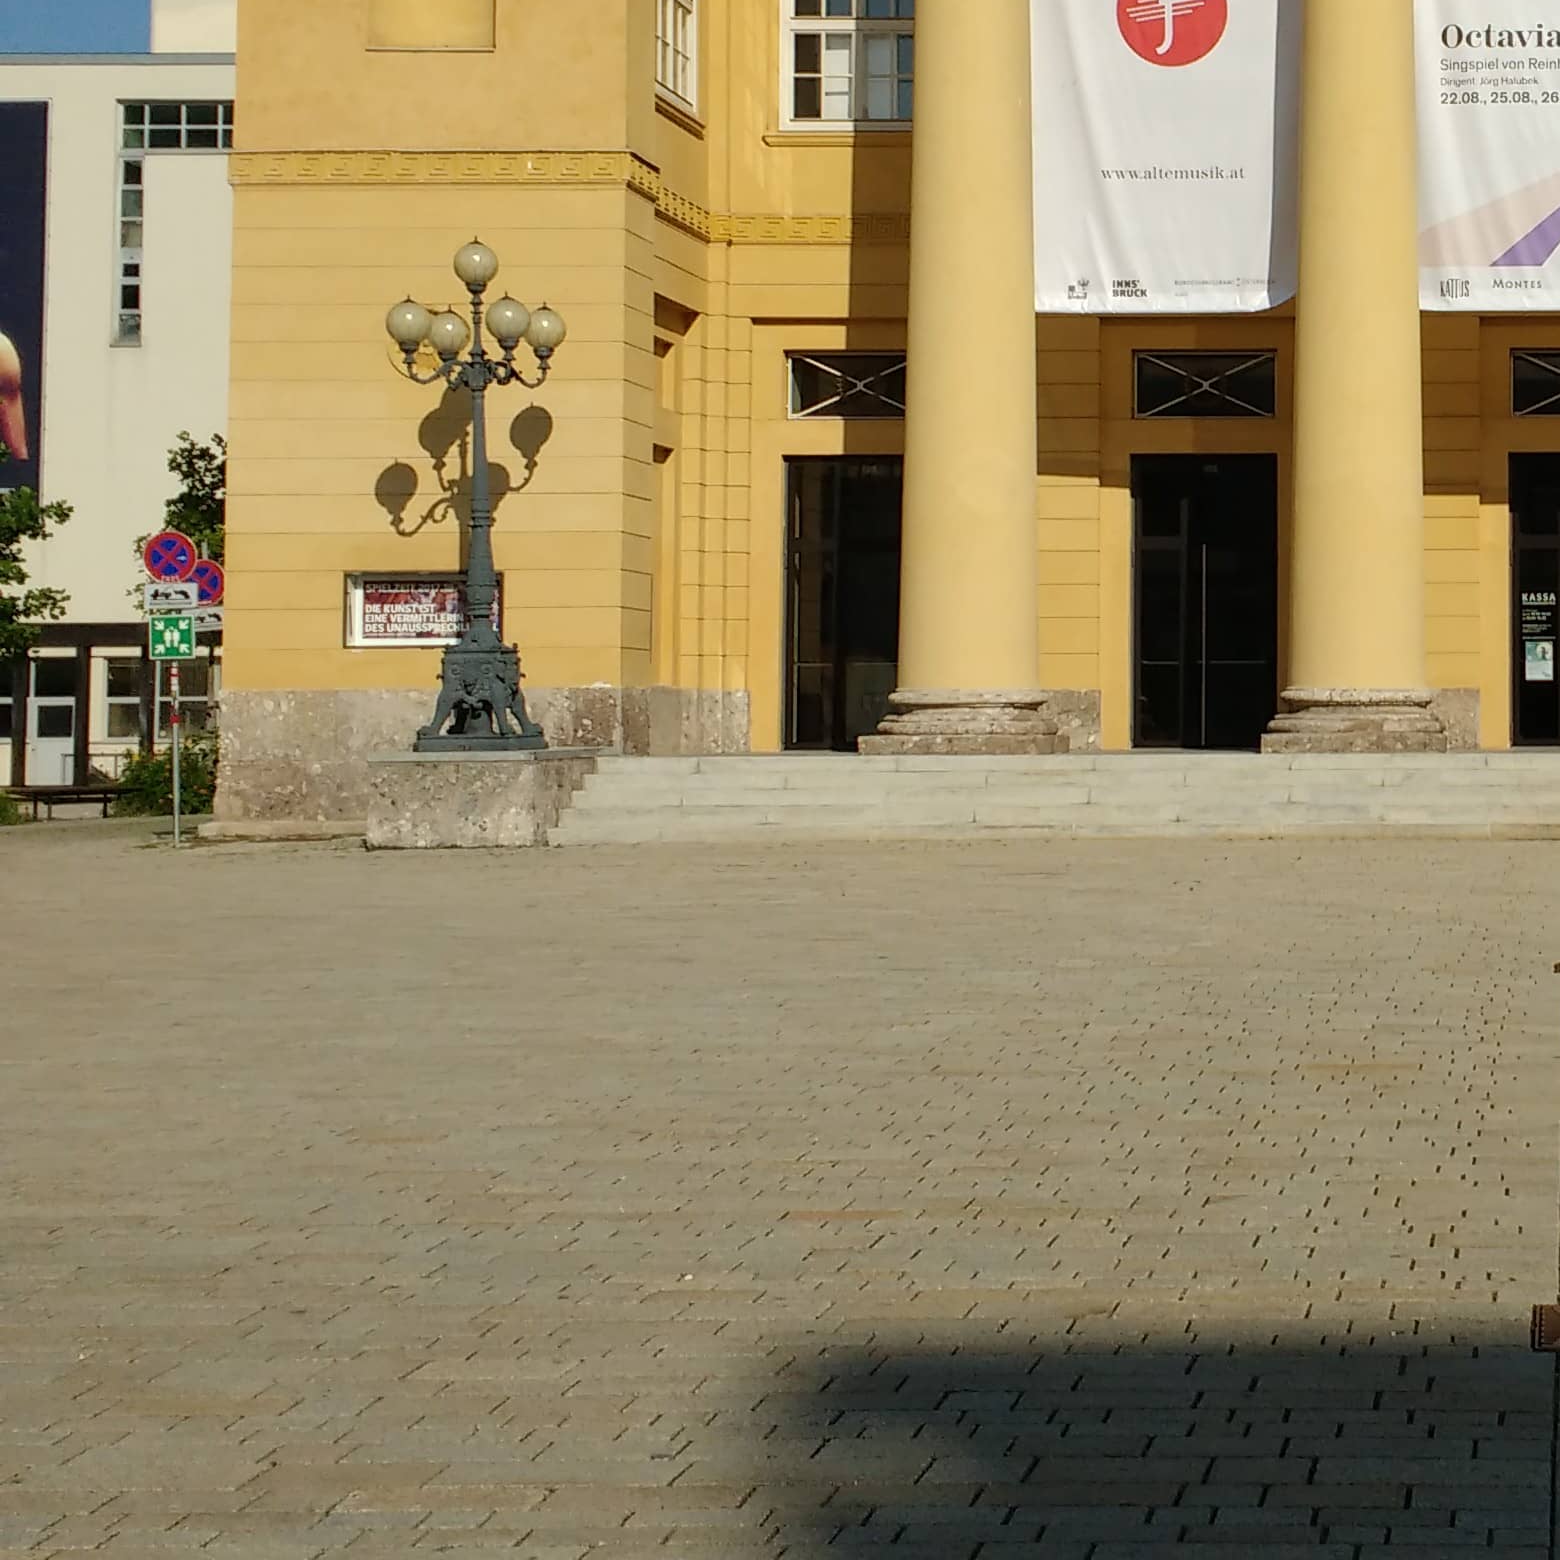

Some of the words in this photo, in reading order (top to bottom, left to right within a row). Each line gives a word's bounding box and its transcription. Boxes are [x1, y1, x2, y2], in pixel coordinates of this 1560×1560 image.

[1440, 58, 1499, 73] Singspiel
[1501, 60, 1525, 70] von
[1440, 91, 1487, 105] 22.08.,
[1490, 91, 1538, 105] 25.08.,
[1101, 164, 1245, 181] www.altemusik.at
[1112, 288, 1148, 298] BRUCK
[1521, 592, 1557, 602] KASSA
[365, 603, 382, 613] DIE
[383, 603, 417, 613] KUNST
[365, 614, 388, 623] EINE
[390, 613, 465, 623] VERMITTLERIN
[365, 623, 384, 633] DES
